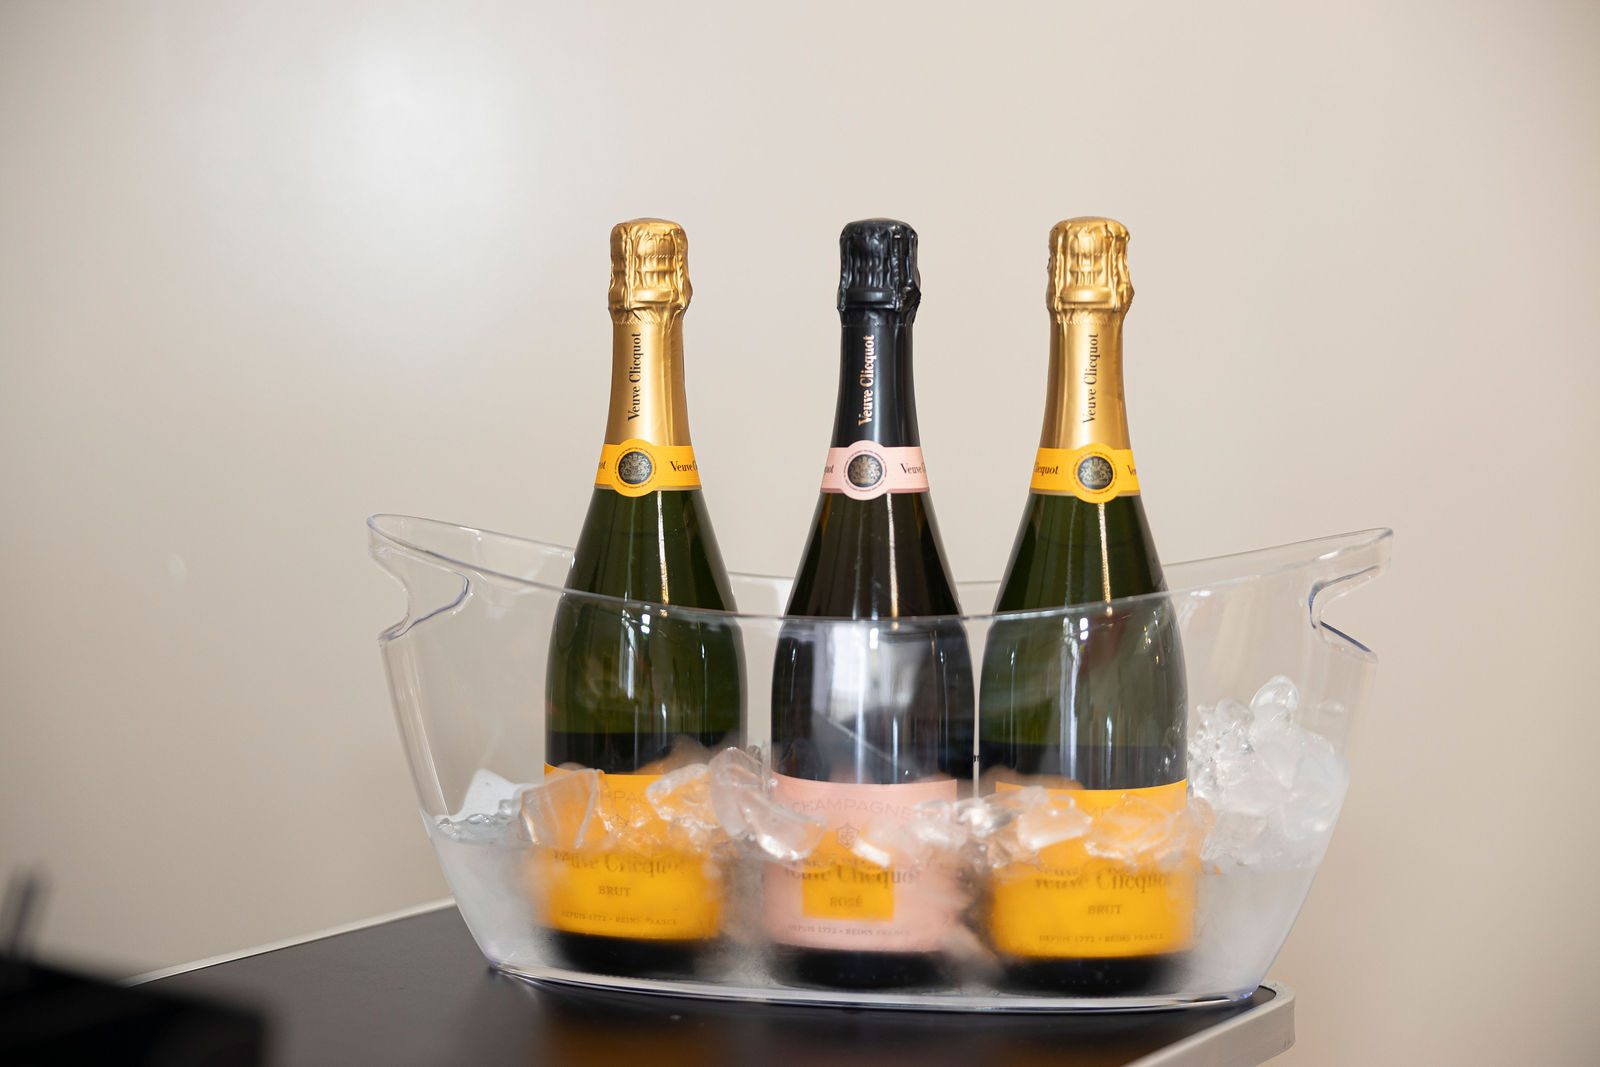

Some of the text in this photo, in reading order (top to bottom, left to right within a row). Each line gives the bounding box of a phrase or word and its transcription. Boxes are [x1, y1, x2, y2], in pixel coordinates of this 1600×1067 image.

[628, 333, 644, 421] Veuve Clicquot
[858, 334, 877, 426] Veuve Clicquot
[1082, 333, 1101, 424] Veuve Clicquot
[670, 460, 693, 472] Veuve
[900, 463, 922, 475] Veuve
[598, 884, 632, 897] BRUT
[829, 895, 864, 908] ROSÉ
[1087, 903, 1123, 915] BRUT
